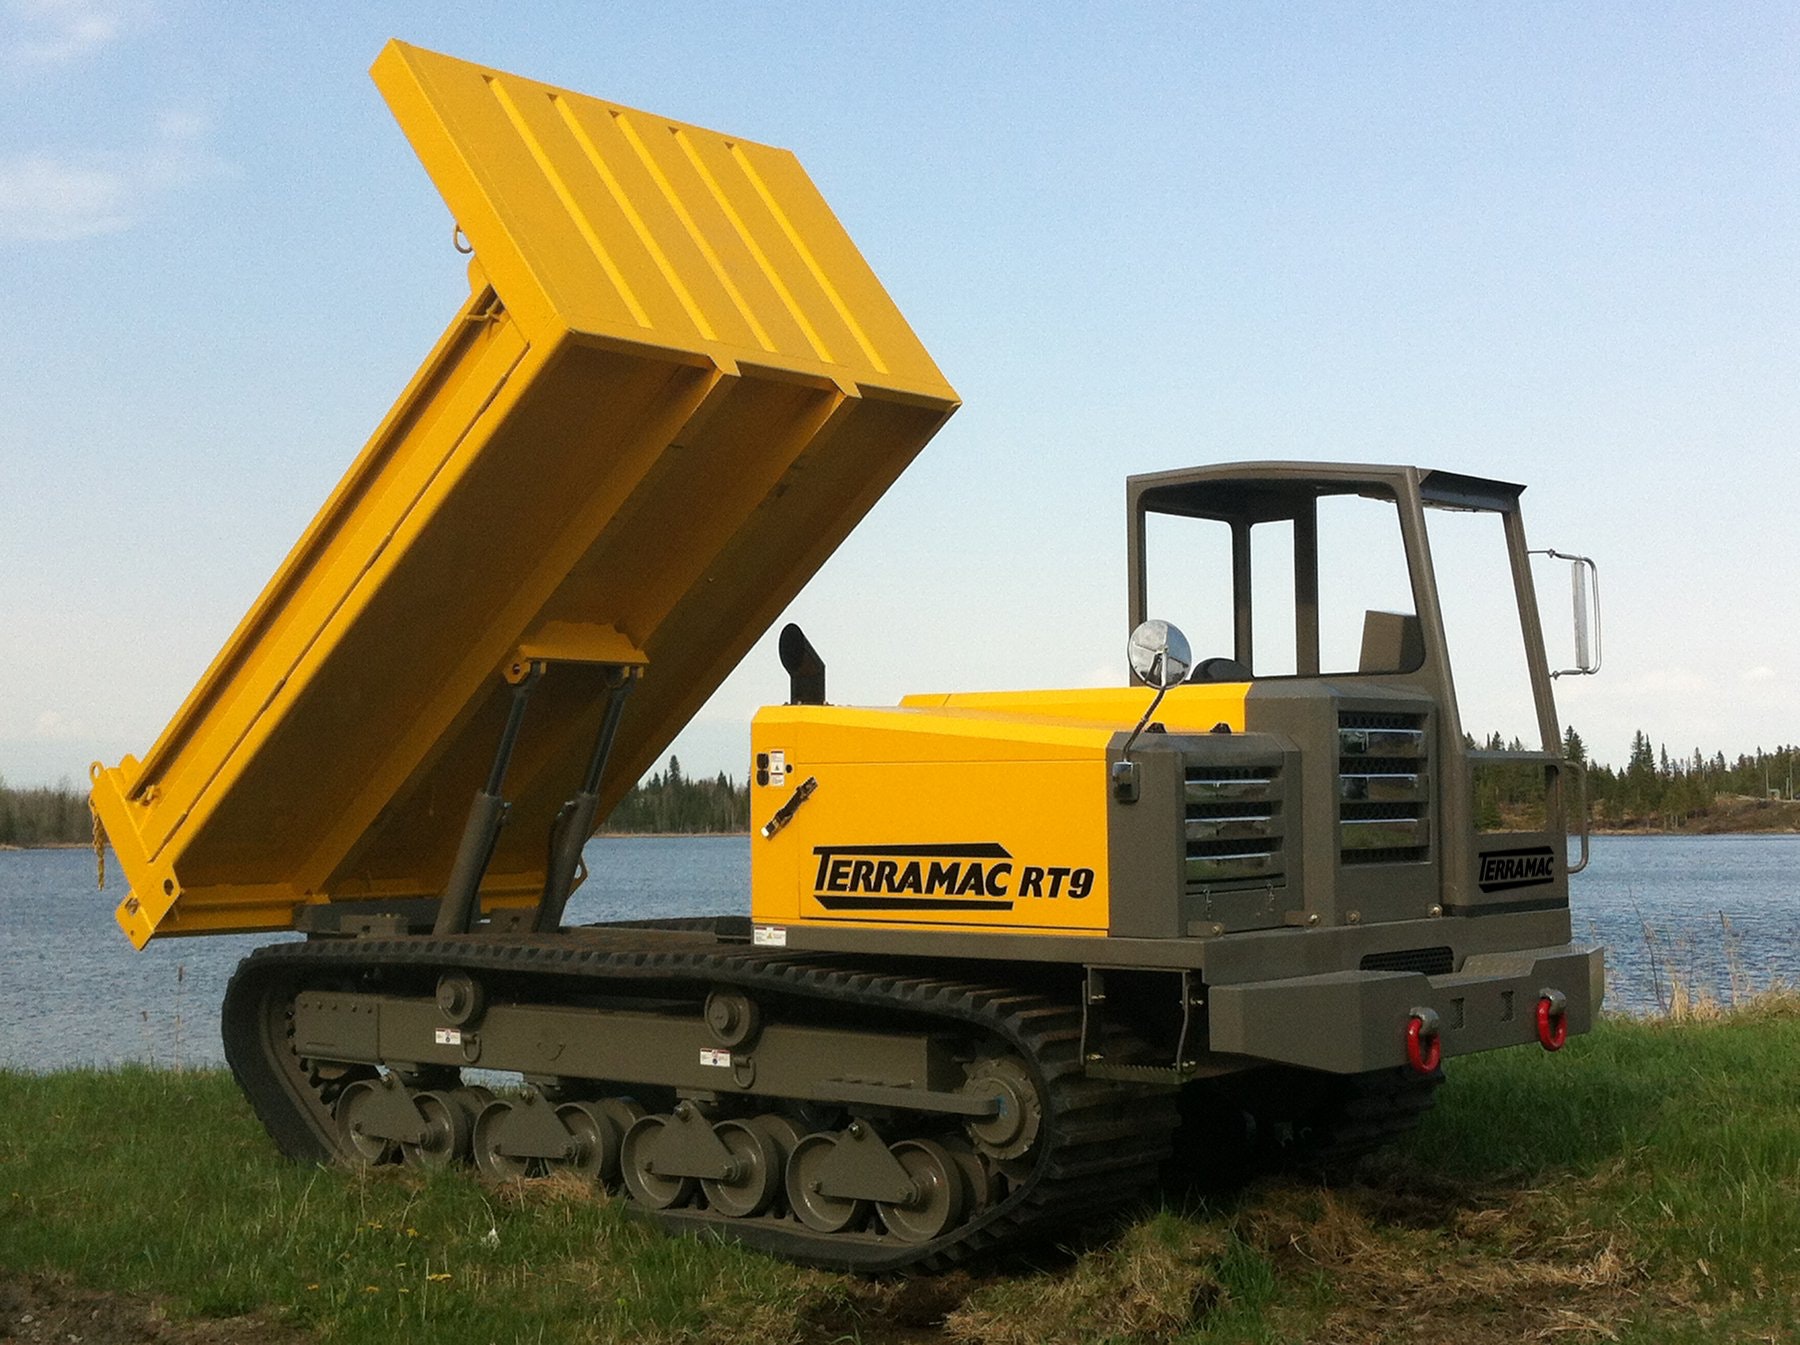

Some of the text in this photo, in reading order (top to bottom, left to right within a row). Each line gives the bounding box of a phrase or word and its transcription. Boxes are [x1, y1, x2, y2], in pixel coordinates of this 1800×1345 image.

[813, 844, 1096, 900] TERRAMAC RT9
[1478, 847, 1554, 882] TERRAMAC
